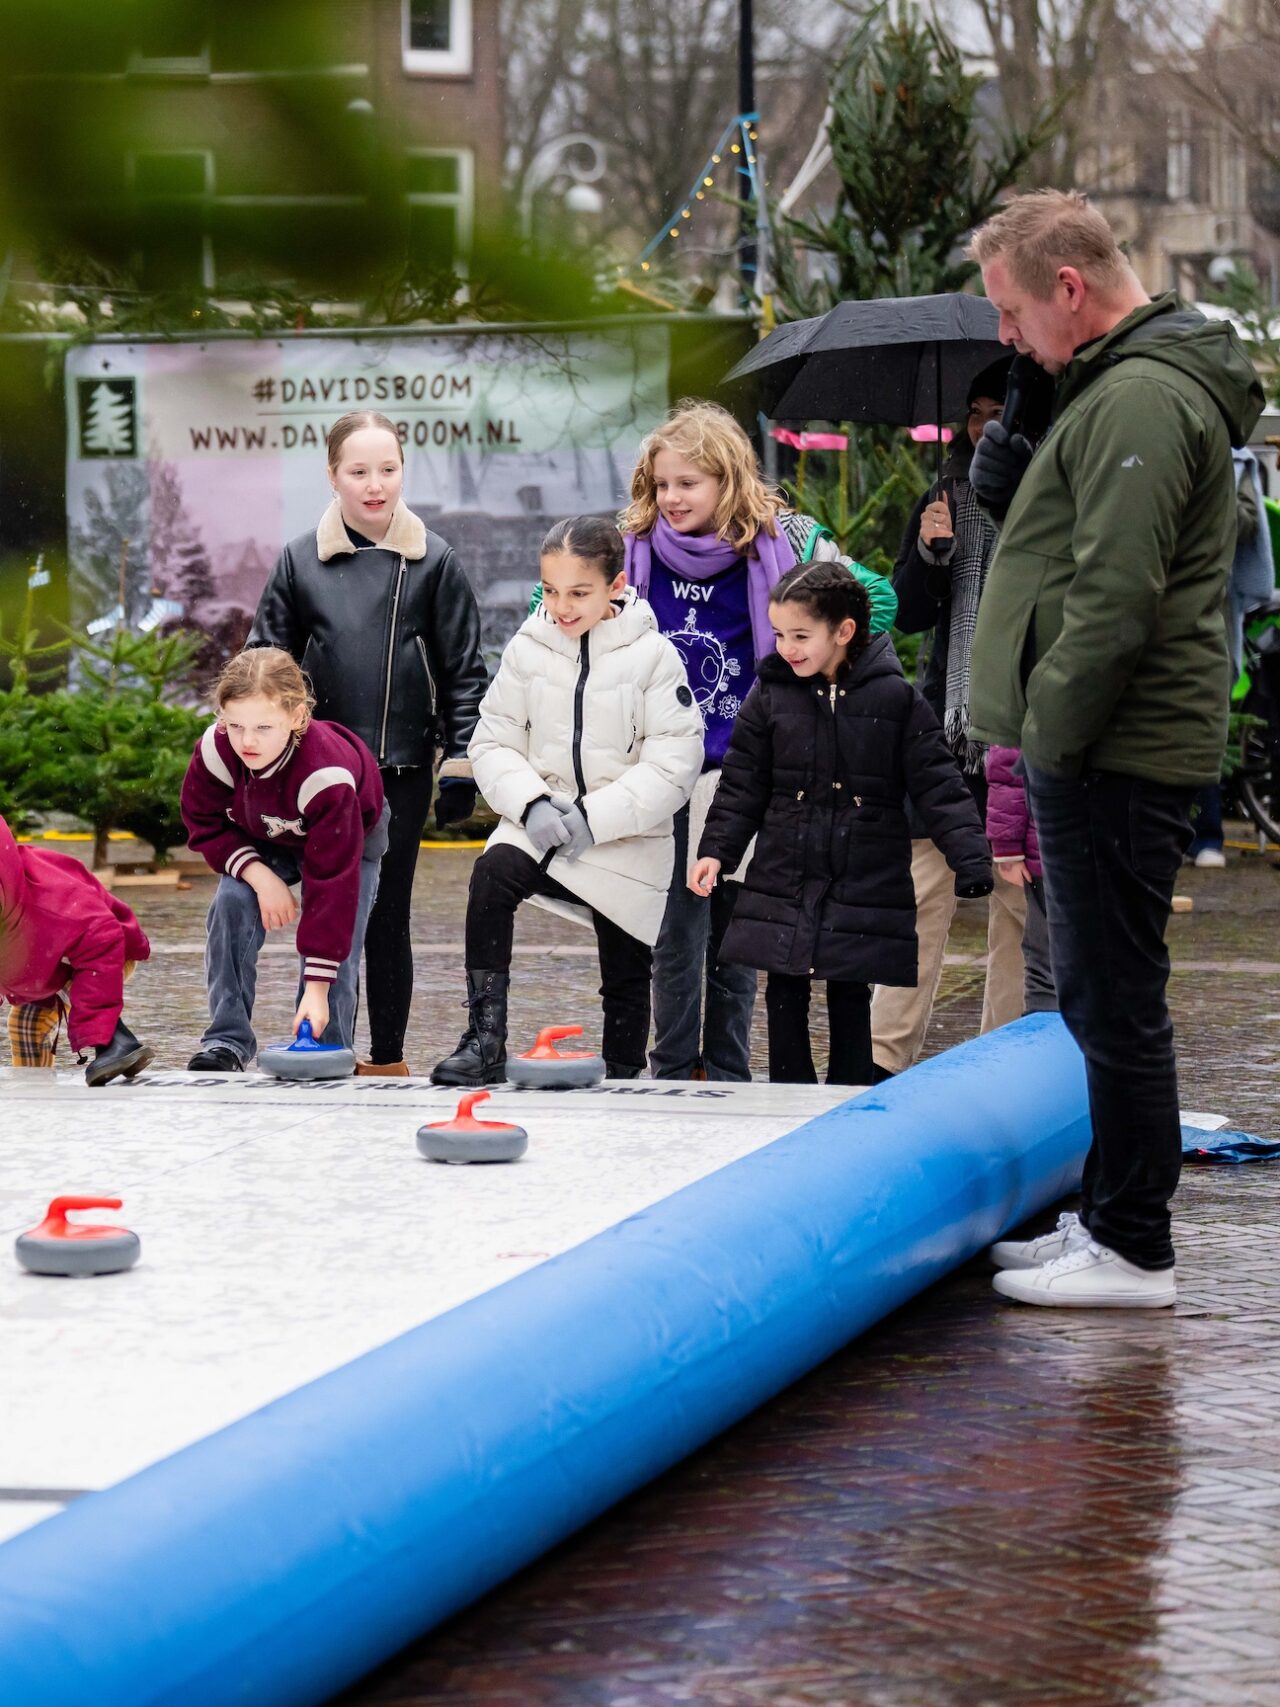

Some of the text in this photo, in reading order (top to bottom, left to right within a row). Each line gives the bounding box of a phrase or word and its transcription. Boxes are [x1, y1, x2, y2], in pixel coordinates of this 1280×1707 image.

[252, 374, 472, 402] #DAVIDSBOOM
[190, 419, 522, 451] WWW.DAVBOOM.NL
[671, 580, 715, 602] WSV
